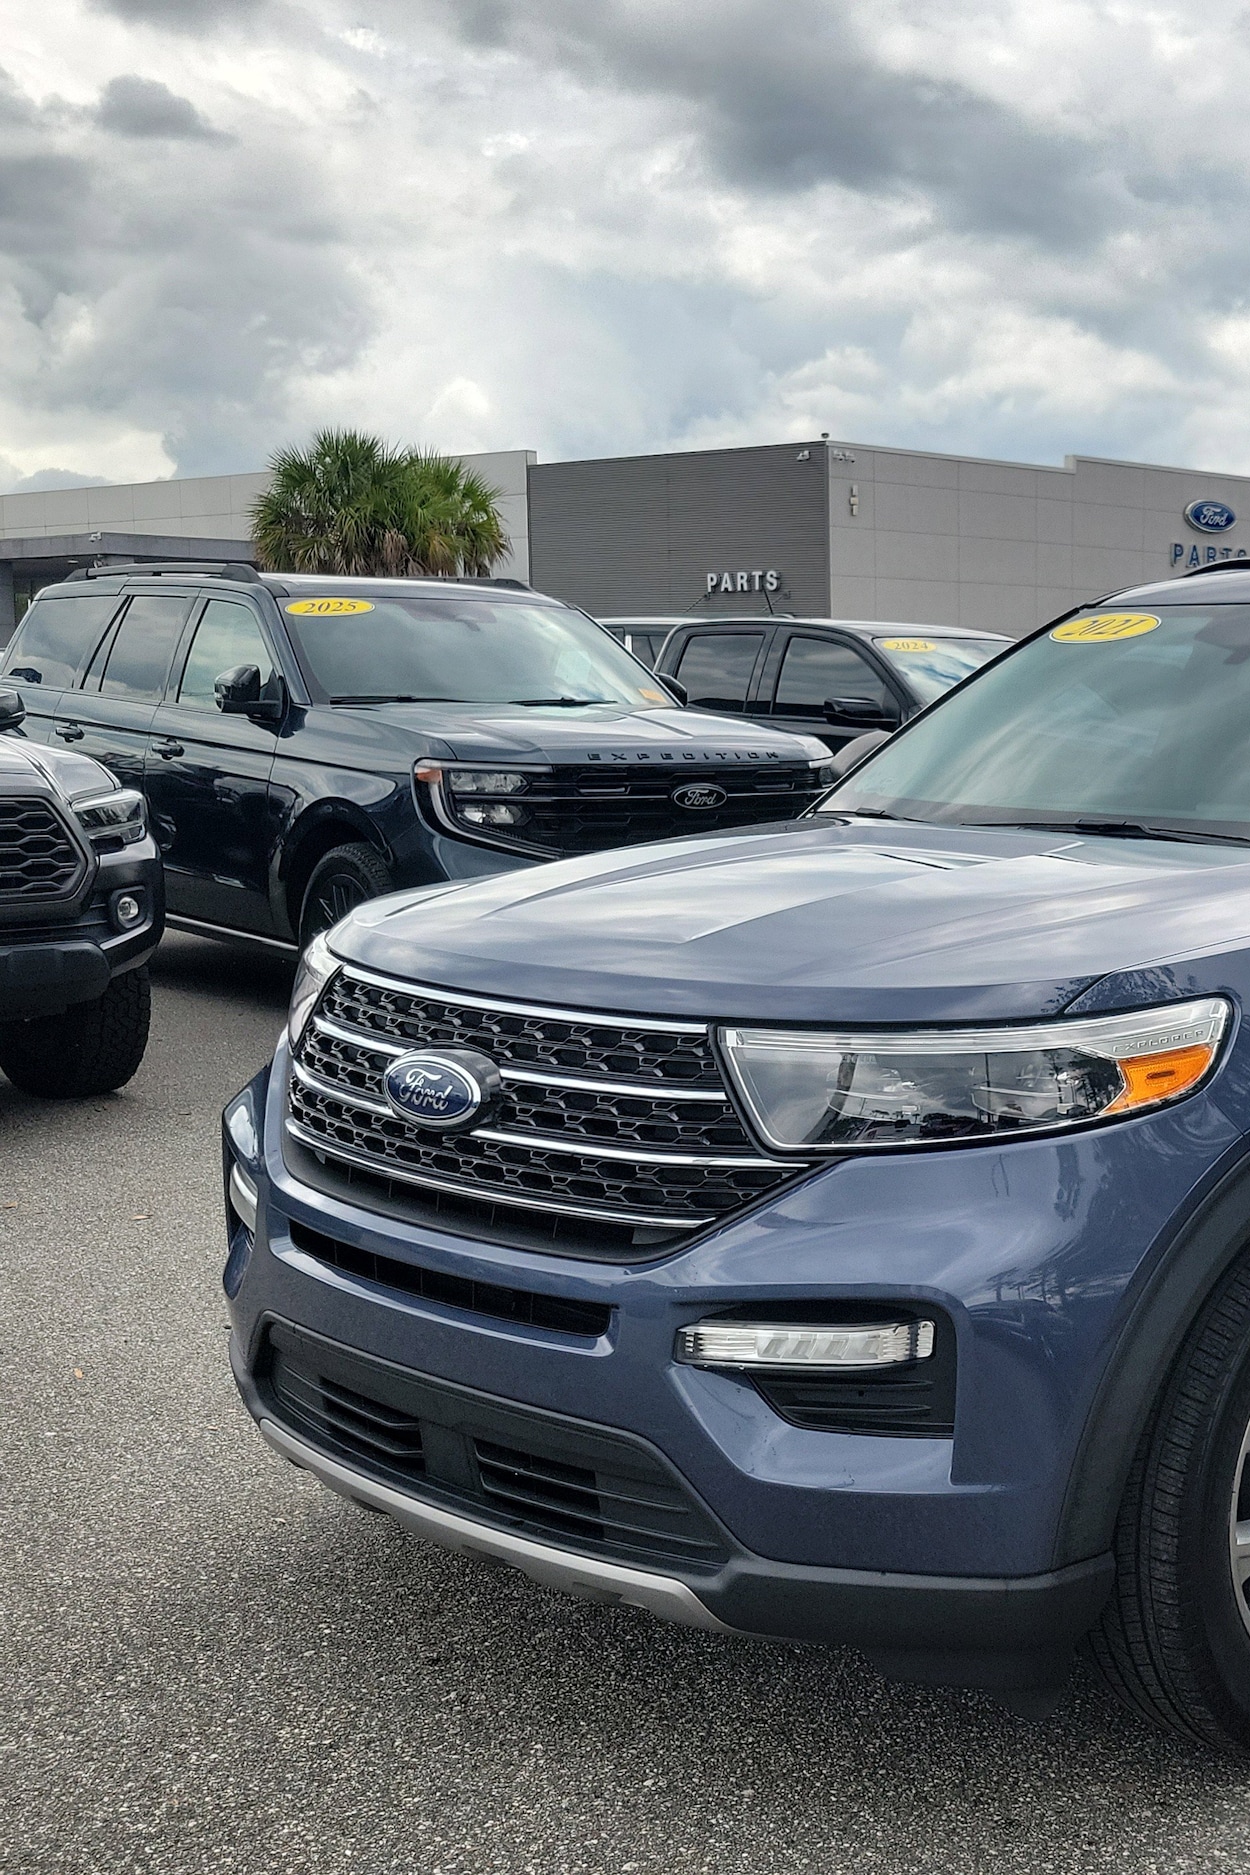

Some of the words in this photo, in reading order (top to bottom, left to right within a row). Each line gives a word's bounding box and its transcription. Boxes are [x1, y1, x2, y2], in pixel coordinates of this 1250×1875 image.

[1201, 506, 1228, 526] Ford
[707, 570, 778, 593] PARTS
[303, 601, 359, 614] 2025
[893, 641, 929, 650] 2024
[587, 751, 780, 761] EXPEDITION
[684, 789, 716, 806] Ford
[399, 1068, 454, 1111] Ford
